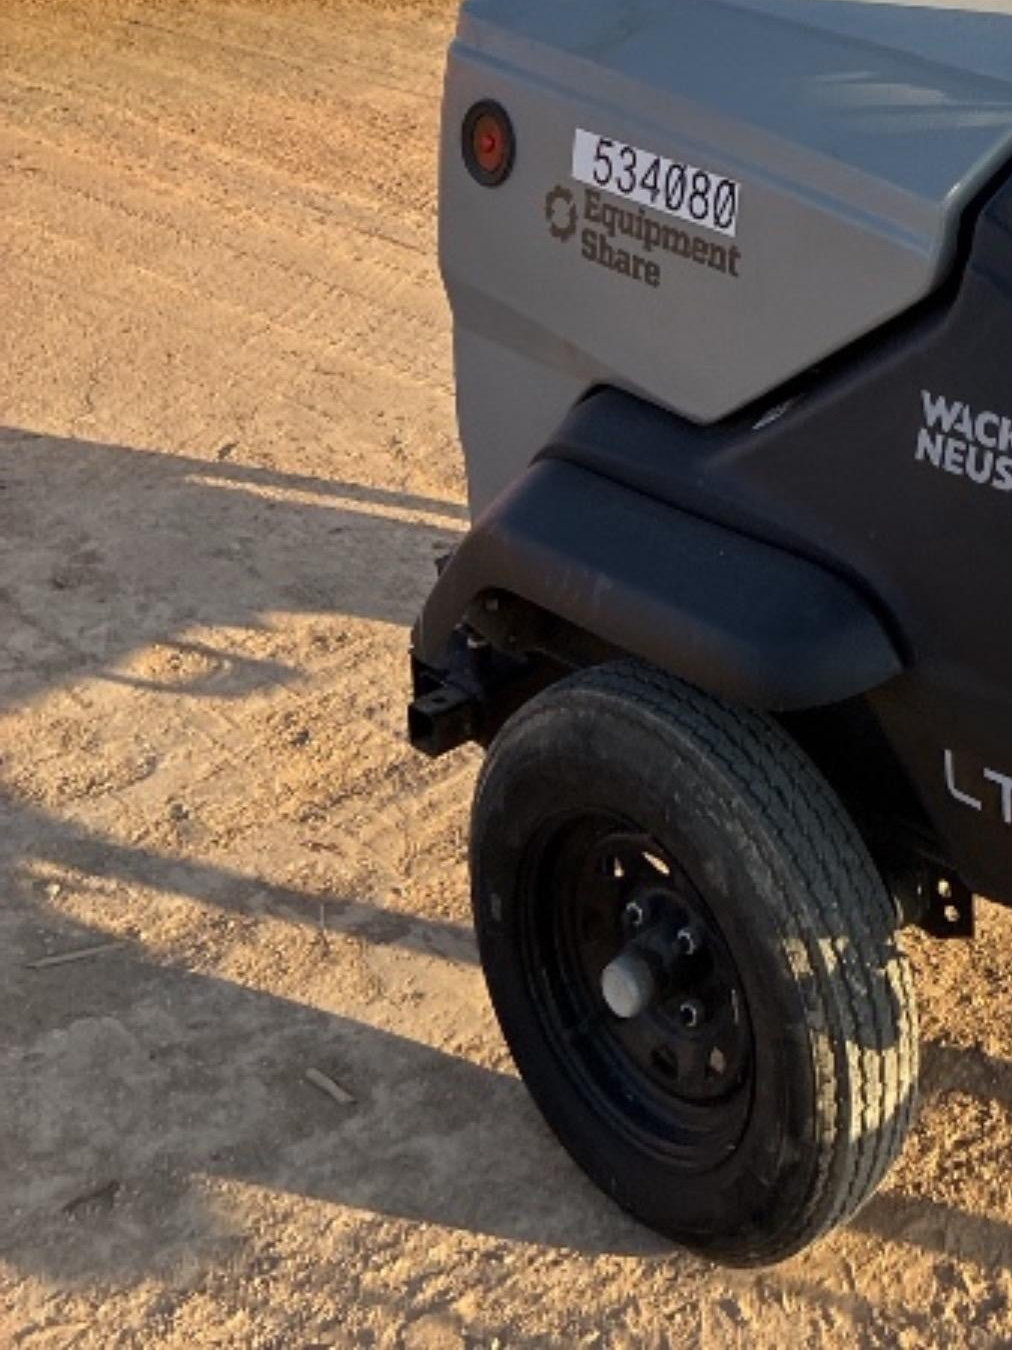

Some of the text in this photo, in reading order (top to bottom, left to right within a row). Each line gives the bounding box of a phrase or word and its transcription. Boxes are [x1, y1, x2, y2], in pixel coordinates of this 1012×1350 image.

[592, 139, 738, 230] 534080
[581, 227, 662, 288] Share
[584, 188, 743, 278] Equipment
